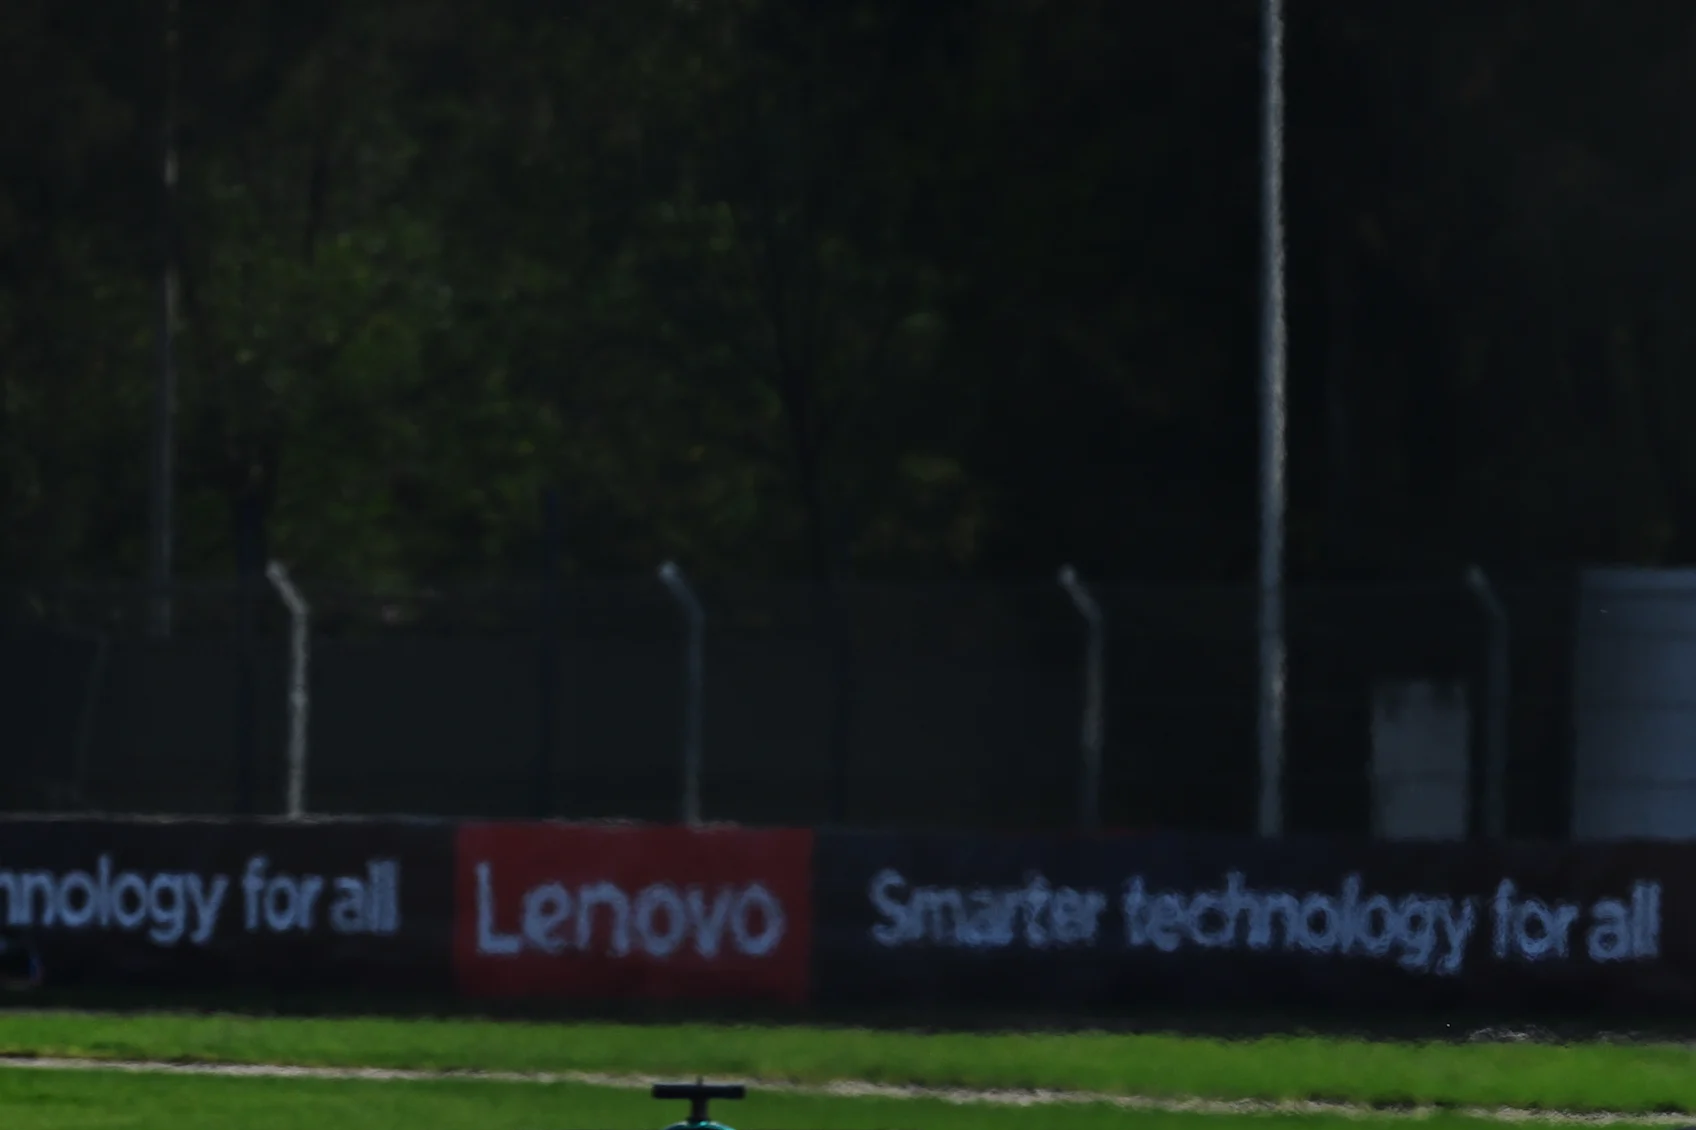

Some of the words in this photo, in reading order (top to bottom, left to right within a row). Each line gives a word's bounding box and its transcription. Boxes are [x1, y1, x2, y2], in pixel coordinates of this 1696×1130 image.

[241, 854, 323, 934] for
[330, 859, 399, 934] all
[474, 861, 786, 957] Lenovo
[867, 868, 1107, 946] Smarter
[1123, 872, 1477, 977] technology
[1493, 877, 1579, 961] for
[1587, 879, 1662, 961] all
